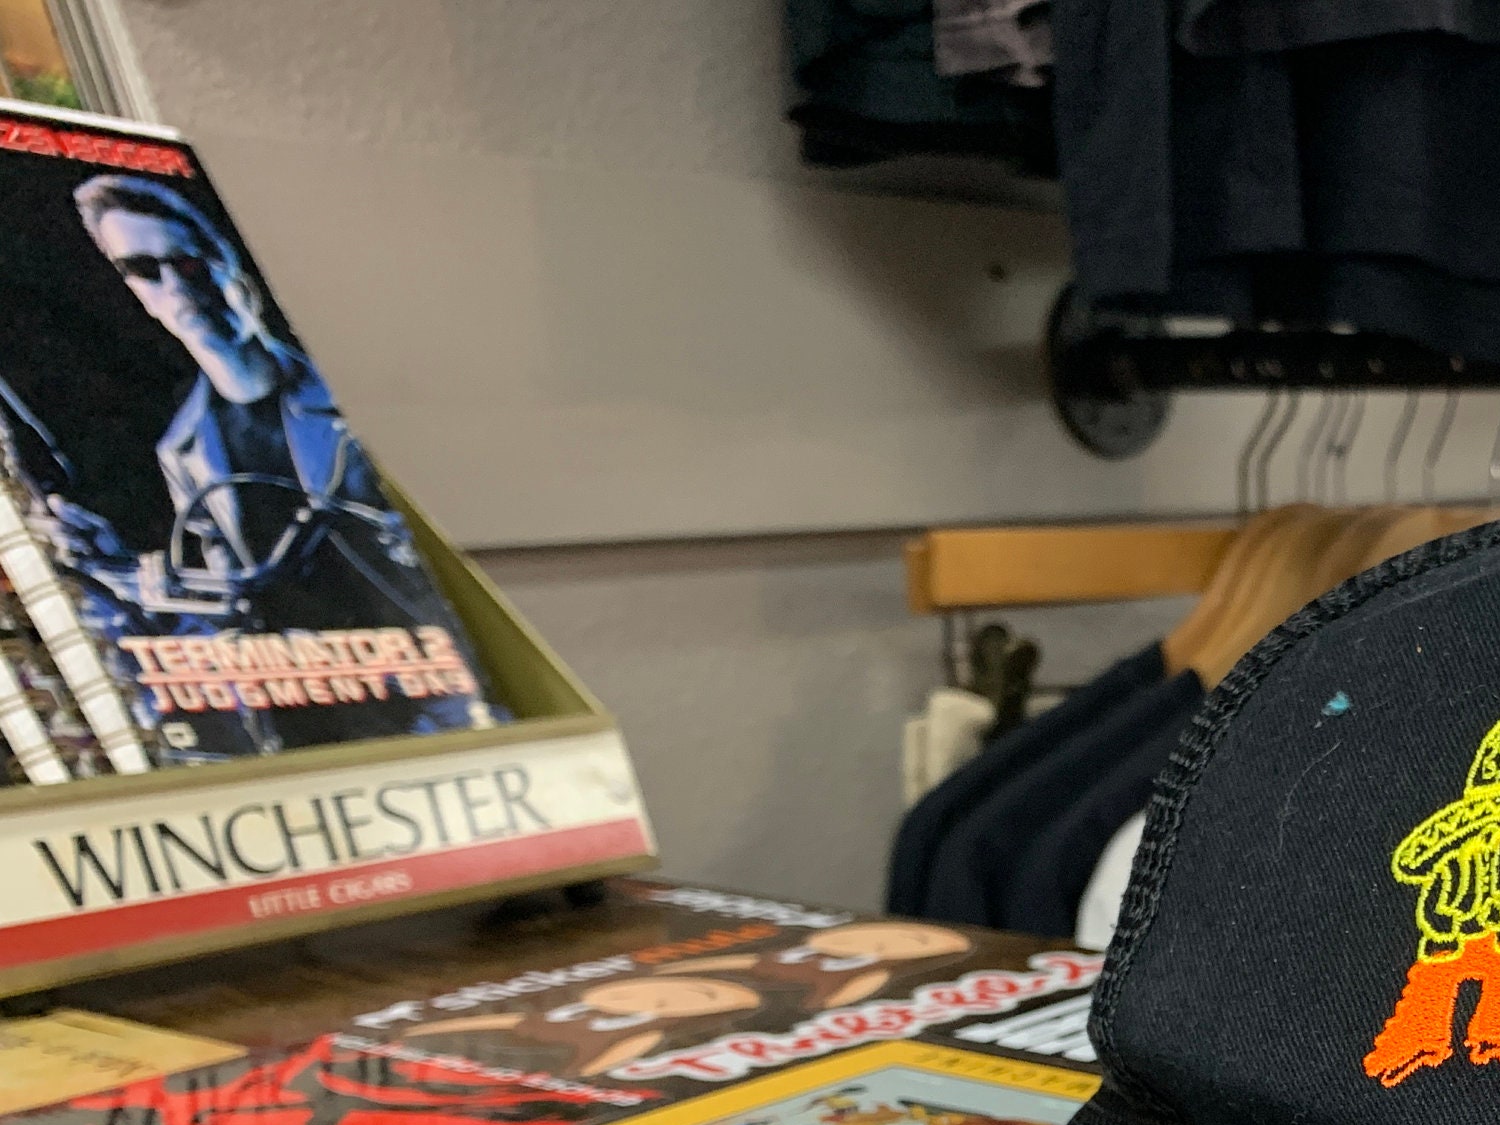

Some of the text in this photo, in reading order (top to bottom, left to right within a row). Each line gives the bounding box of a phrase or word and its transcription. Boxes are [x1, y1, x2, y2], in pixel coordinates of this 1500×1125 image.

[118, 625, 456, 674] TERMINATOR 2
[151, 674, 390, 713] JUDGMENT
[34, 762, 553, 908] WINCHESTER
[248, 868, 415, 919] LITTLE CIGARS
